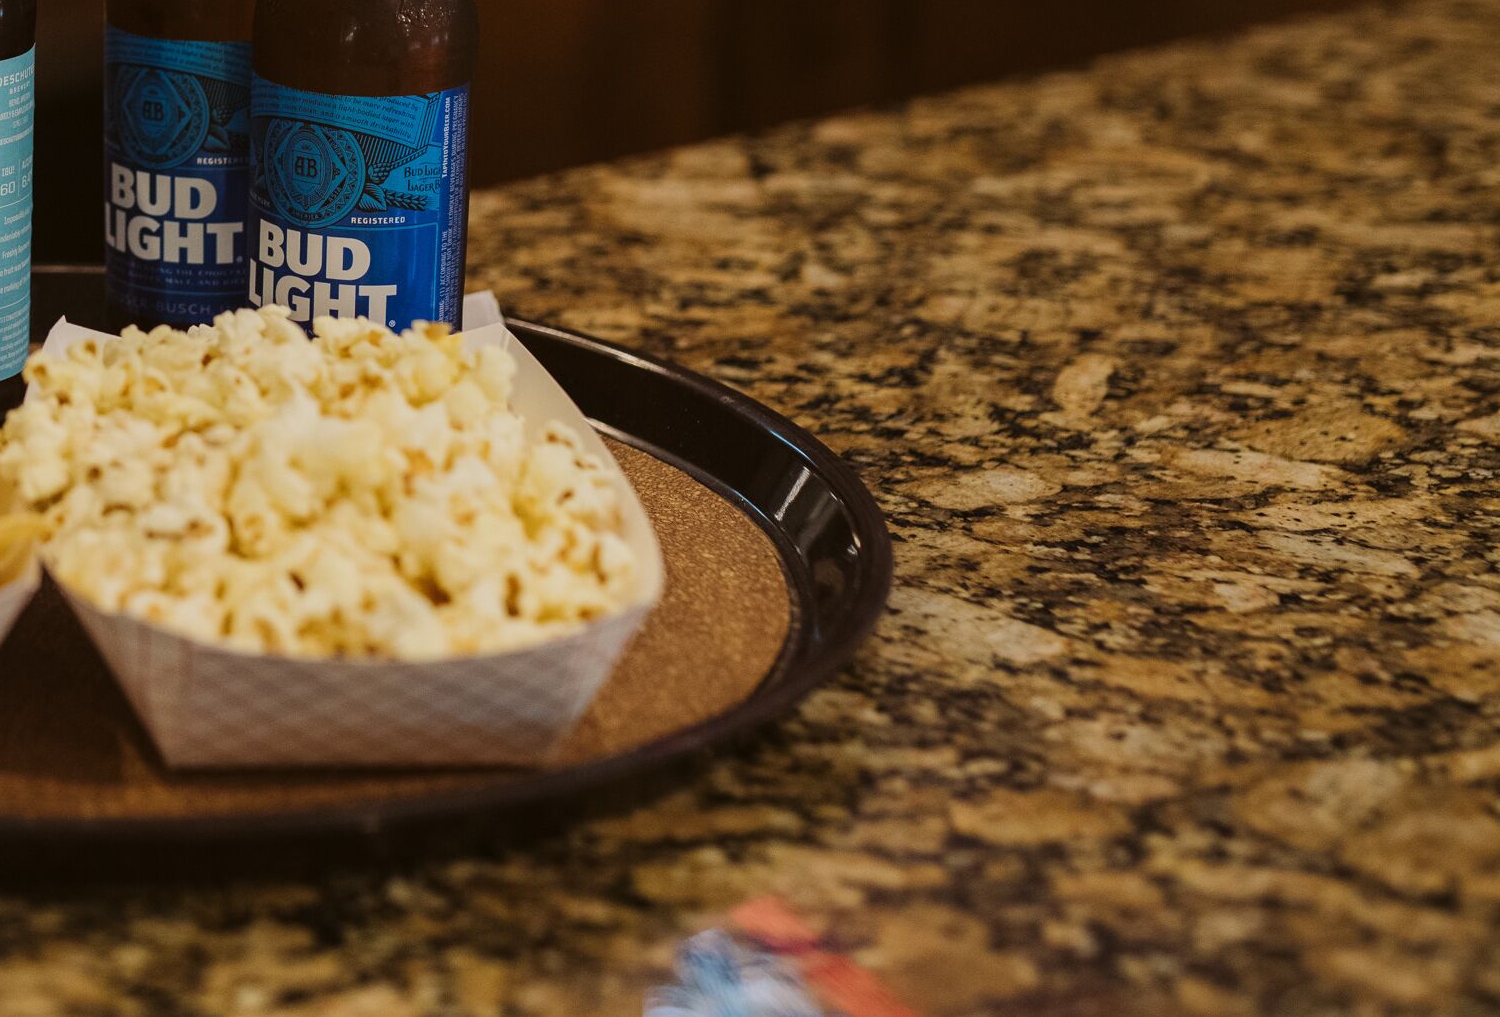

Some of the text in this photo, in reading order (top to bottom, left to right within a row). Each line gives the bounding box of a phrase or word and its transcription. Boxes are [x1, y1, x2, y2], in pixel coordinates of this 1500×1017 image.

[0, 181, 16, 196] 60
[424, 165, 440, 176] LIG
[112, 162, 217, 219] BUD
[105, 200, 243, 264] LIGHT
[351, 216, 406, 225] REGISTERED
[259, 218, 371, 281] BUD
[441, 243, 447, 251] TO
[249, 258, 397, 327] LIGHT
